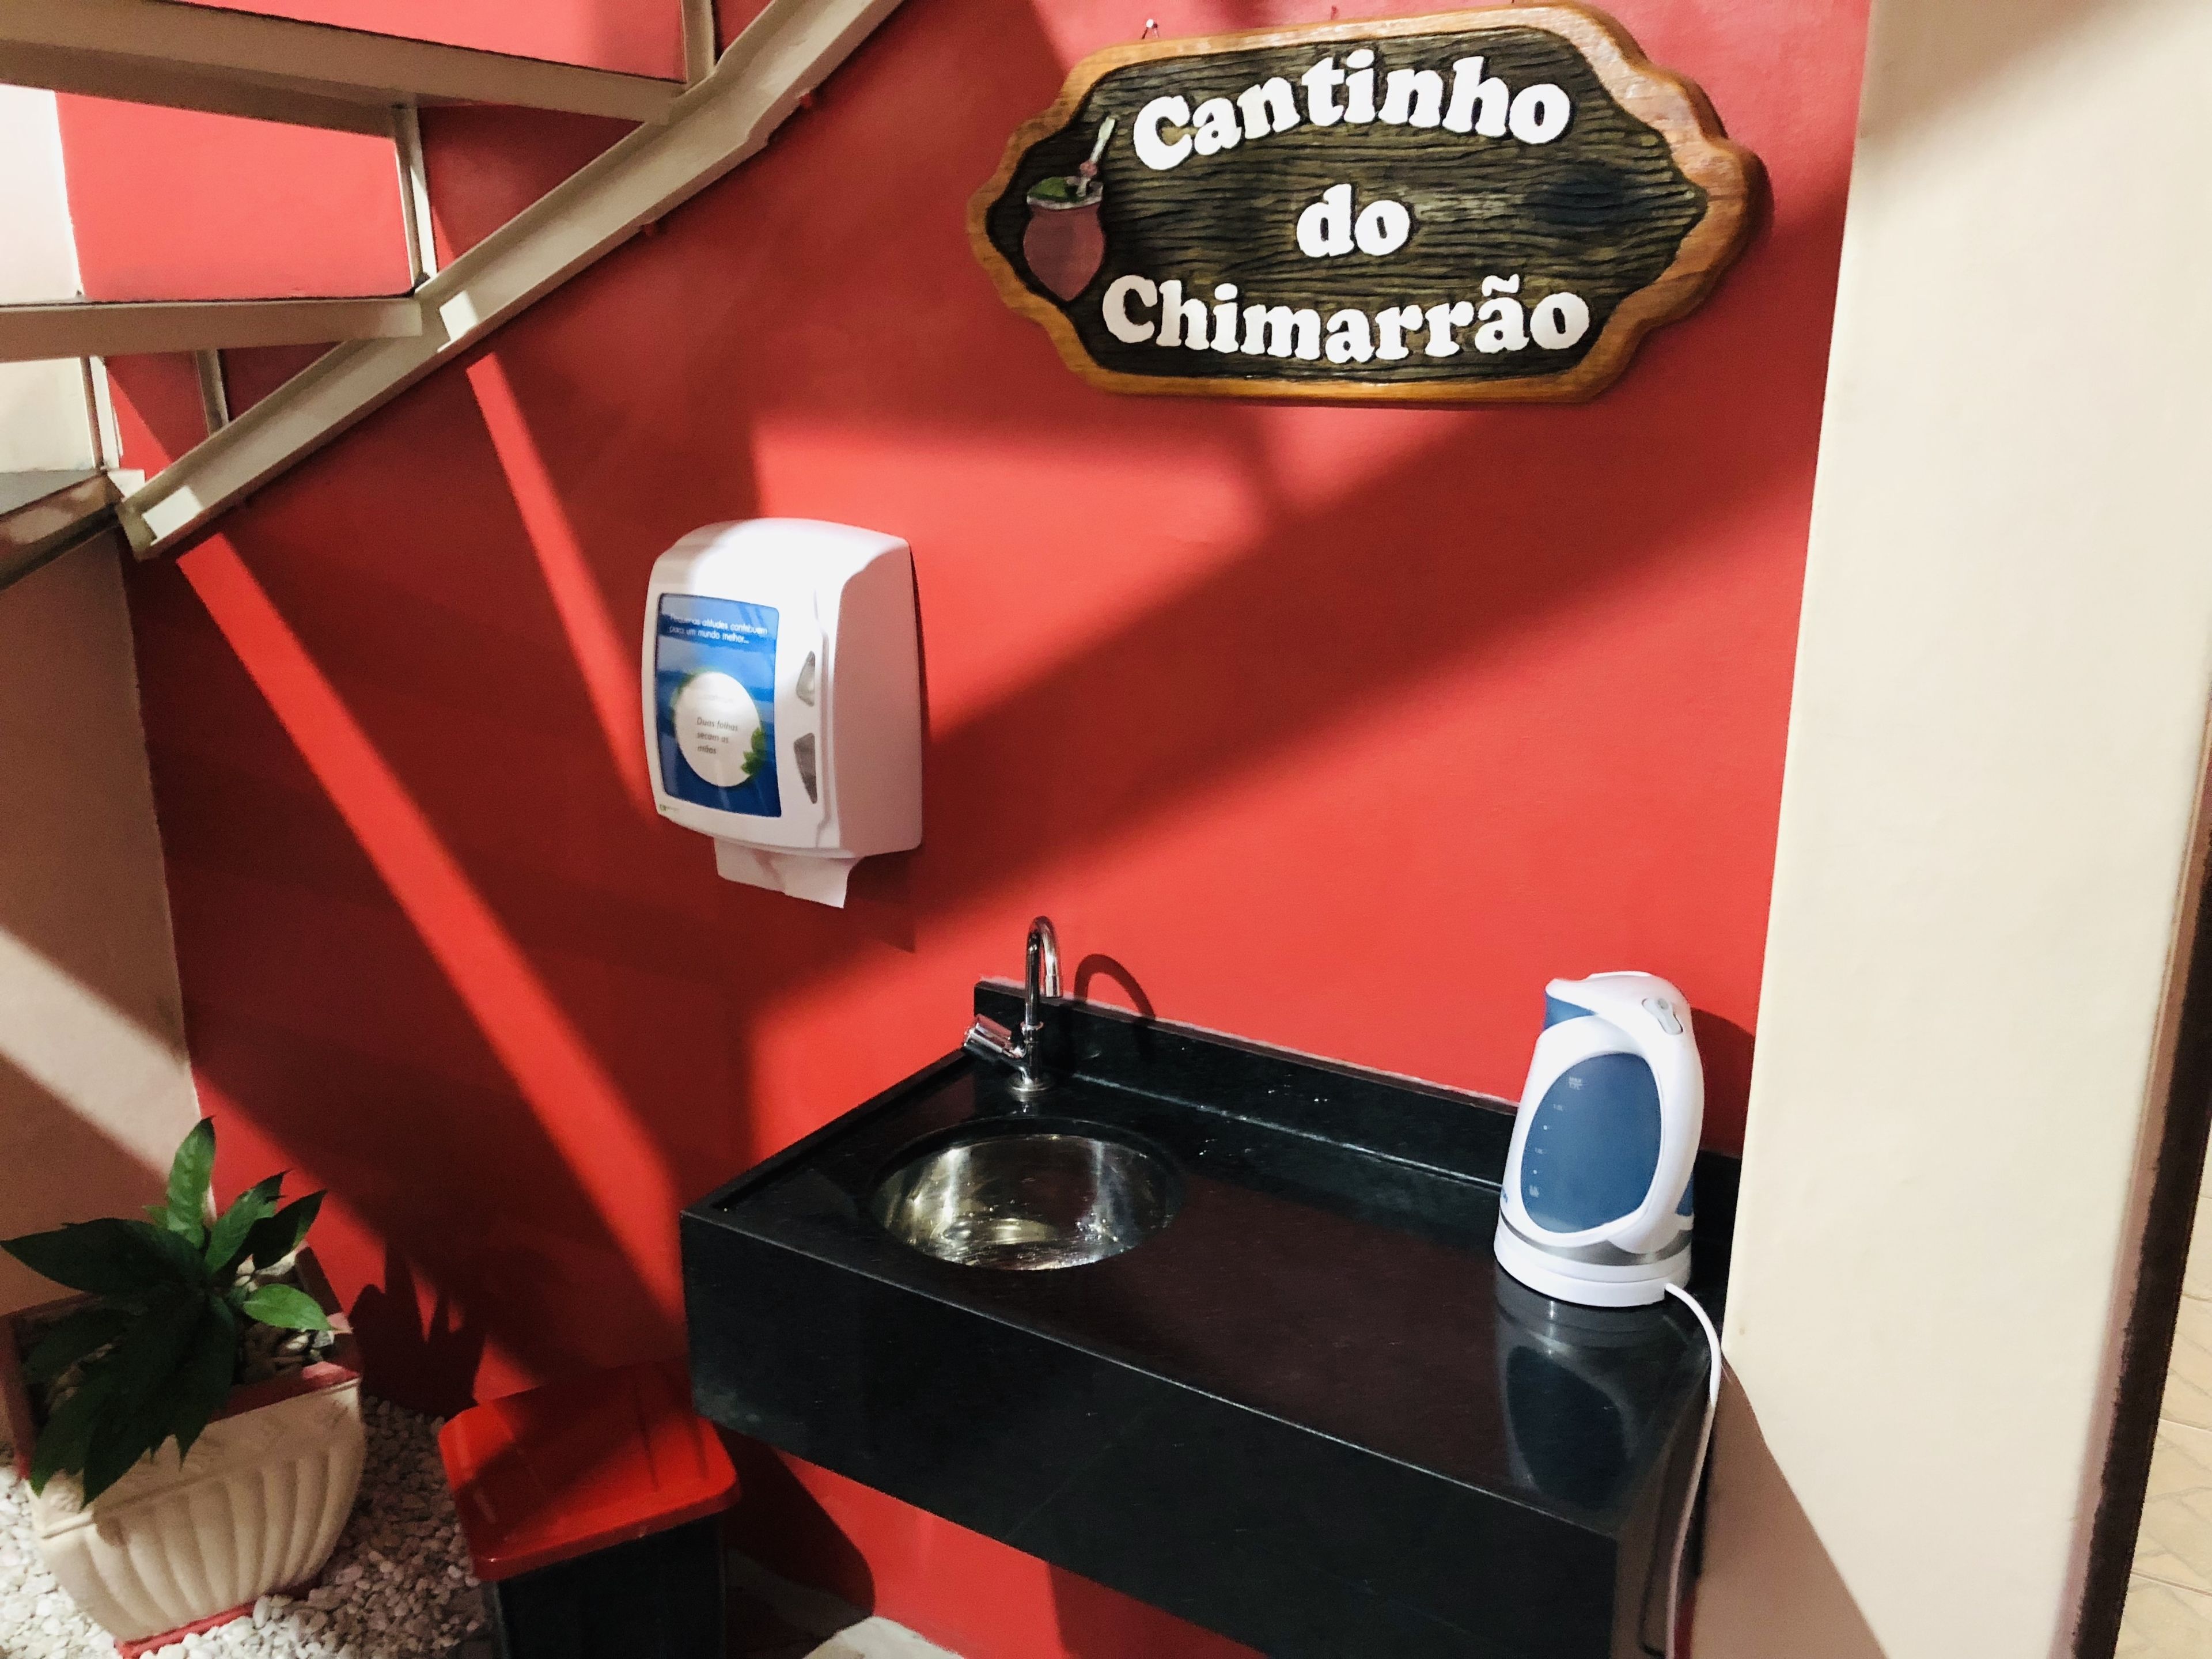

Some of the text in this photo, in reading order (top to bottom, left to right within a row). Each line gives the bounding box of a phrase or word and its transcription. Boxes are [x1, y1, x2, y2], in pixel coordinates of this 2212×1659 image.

[1132, 48, 1571, 171] Cantinho
[1296, 183, 1411, 257] do
[1102, 274, 1590, 364] Chimarrão
[702, 618, 728, 630] atitudes
[698, 630, 720, 639] mundo
[696, 717, 738, 732] Duas folhas
[697, 732, 719, 741] secam
